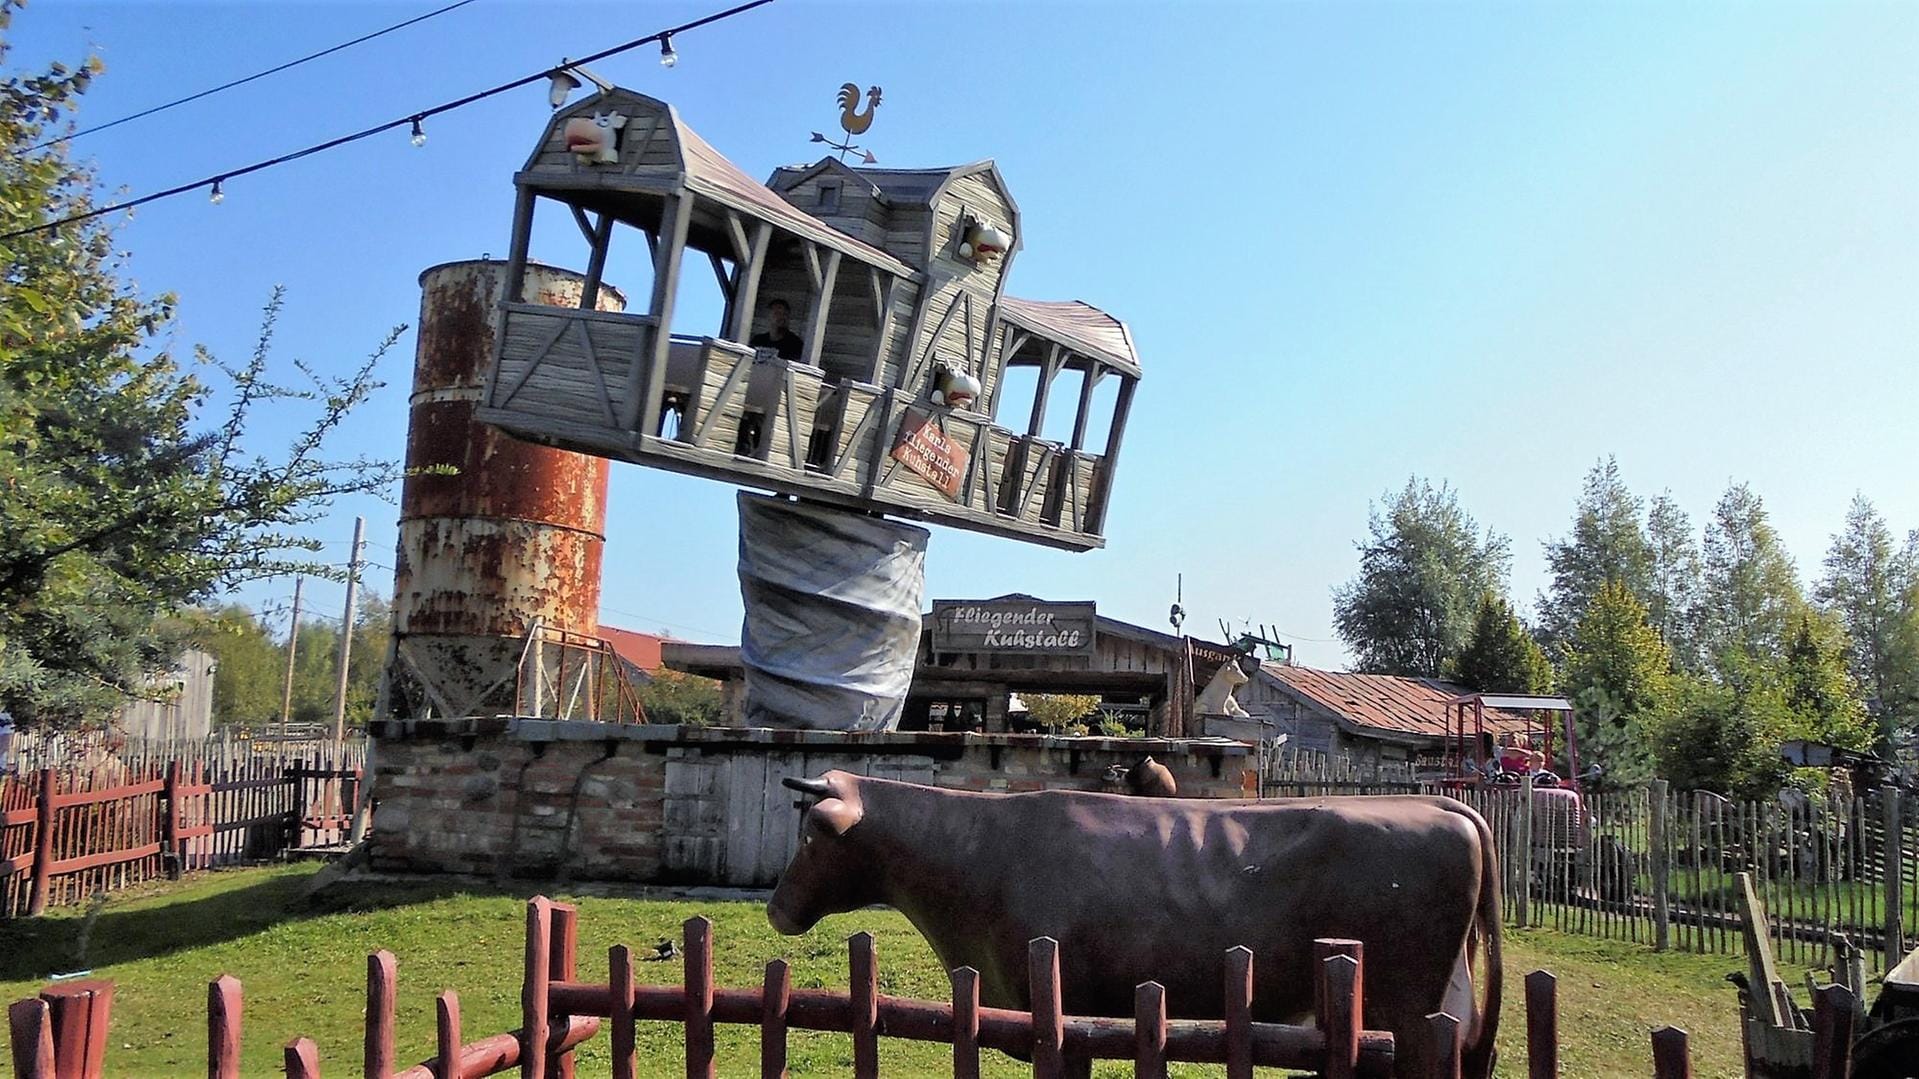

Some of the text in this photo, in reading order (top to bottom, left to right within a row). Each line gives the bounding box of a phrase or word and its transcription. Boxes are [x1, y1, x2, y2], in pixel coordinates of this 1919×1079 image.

[922, 424, 952, 454] Karls
[903, 446, 950, 489] Kuhstall
[953, 606, 1055, 628] Fliegender
[984, 629, 1080, 648] Kuhstall
[1185, 643, 1231, 662] Ausgan
